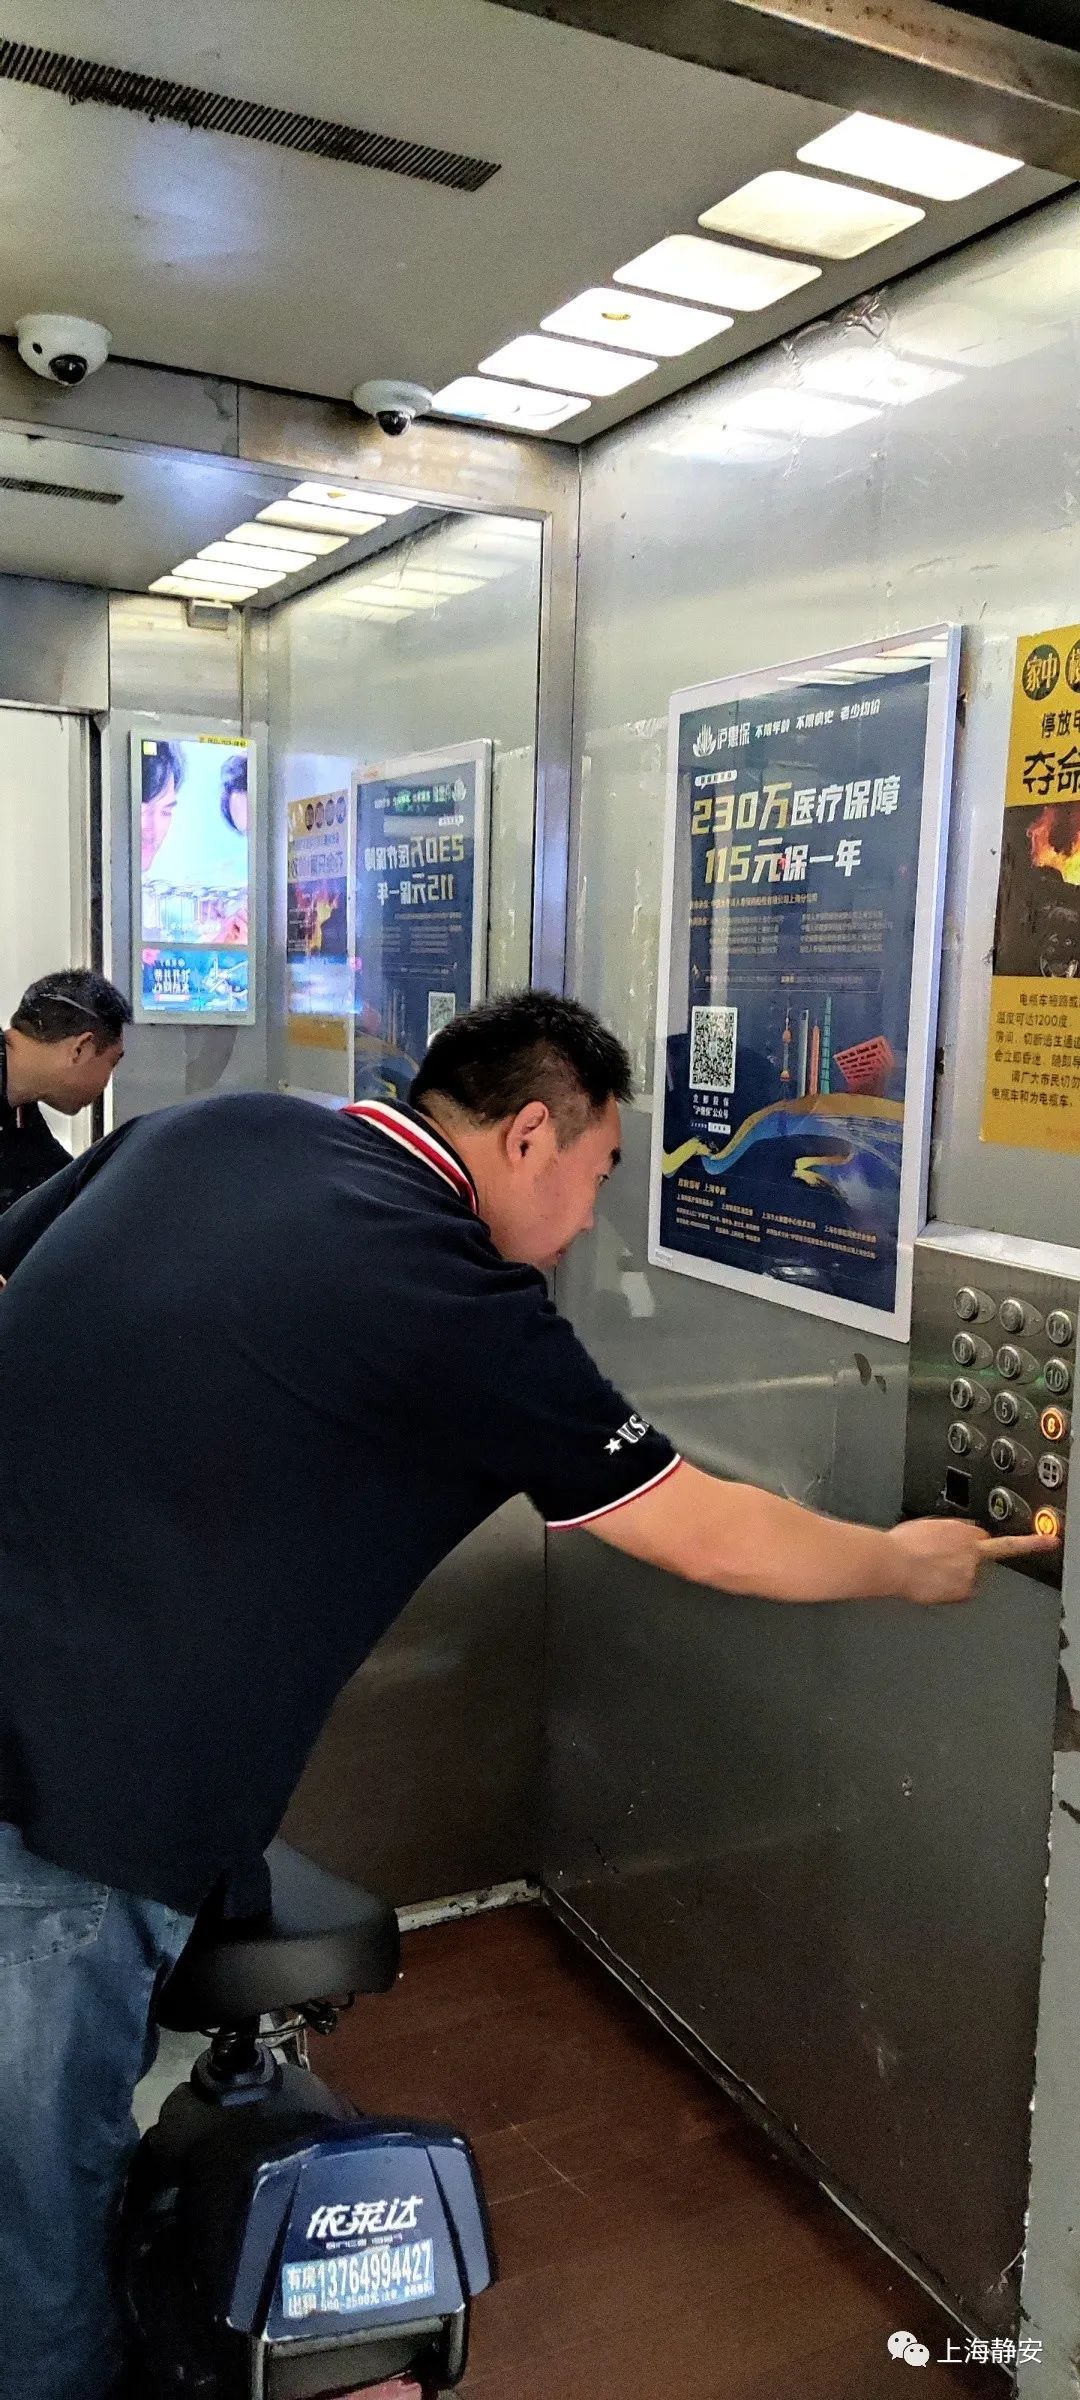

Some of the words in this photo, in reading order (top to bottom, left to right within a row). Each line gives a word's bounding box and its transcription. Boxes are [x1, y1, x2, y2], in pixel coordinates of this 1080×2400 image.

[1026, 652, 1058, 692] 家中
[1022, 745, 1080, 796] 夺命
[691, 774, 901, 835] 230万医疗保障
[705, 837, 863, 884] 115元保一年
[1049, 1369, 1062, 1388] 10
[306, 2195, 423, 2239] 依莱达
[318, 2239, 432, 2303] 13764994427
